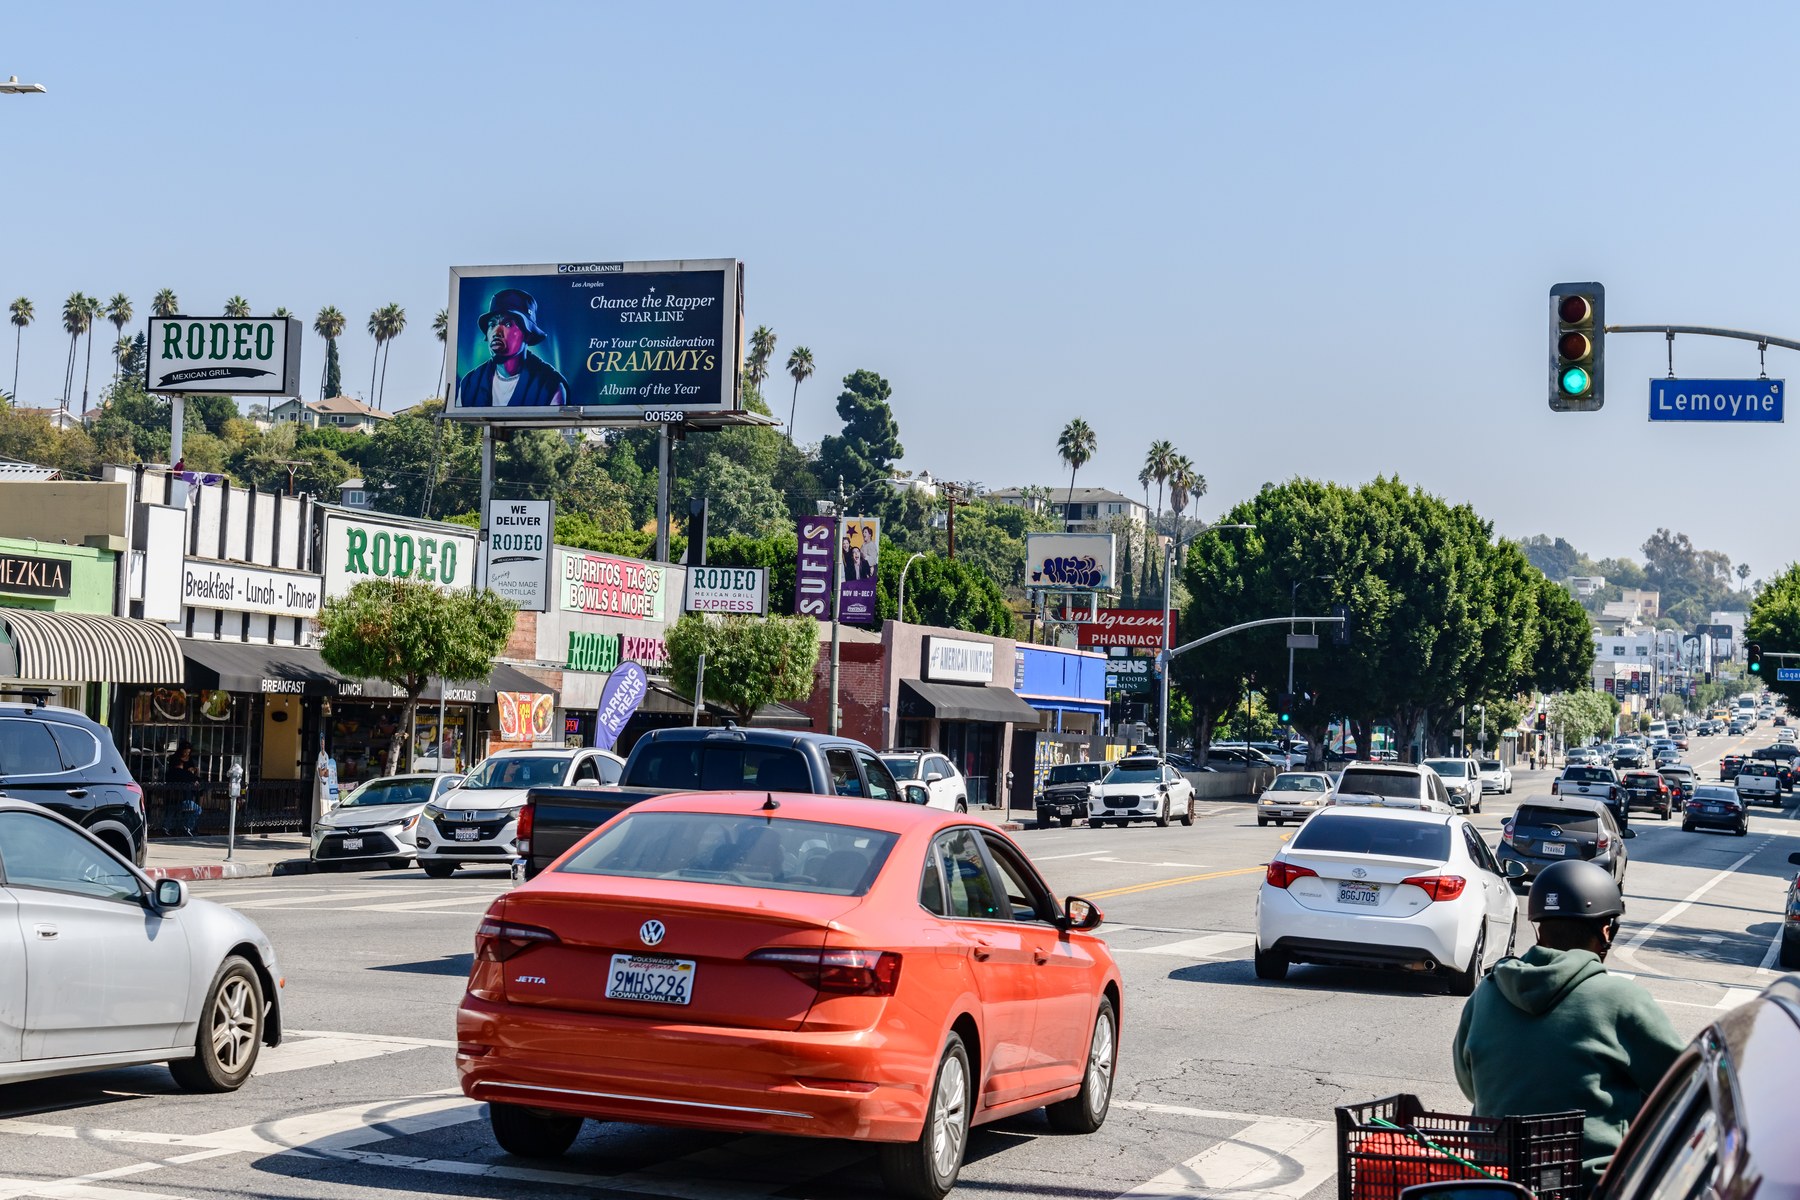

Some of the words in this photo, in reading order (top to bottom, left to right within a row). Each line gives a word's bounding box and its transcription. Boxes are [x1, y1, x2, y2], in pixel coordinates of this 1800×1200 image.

[582, 280, 604, 289] Angeles
[590, 296, 638, 309] Chance
[641, 295, 662, 308] the
[665, 294, 715, 310] Rapper
[620, 311, 652, 323] STAR
[654, 310, 685, 322] LINE
[162, 322, 275, 361] RODEO
[588, 338, 608, 349] For
[611, 338, 637, 348] Your
[639, 336, 715, 348] Consideration
[586, 350, 715, 373] GRAMMYs
[172, 370, 207, 381] MEXICAN
[208, 369, 231, 377] GRILL
[599, 383, 638, 395] Album
[639, 383, 654, 398] of
[653, 384, 672, 395] the
[674, 383, 701, 395] Year
[1659, 389, 1775, 417] Lemoyne
[645, 411, 684, 422] 001526
[510, 505, 527, 514] WE
[496, 516, 541, 526] DELIVER
[492, 533, 543, 551] RODEO
[345, 526, 457, 585] RODEO
[566, 556, 624, 592] BURRITOS,
[626, 566, 660, 593] TACOS
[800, 524, 829, 614] SUFFS
[693, 569, 756, 591] RODEO
[185, 571, 234, 601] Breakfast
[246, 577, 275, 605] Lunch
[286, 582, 317, 610] Dinner
[500, 588, 537, 596] TORTILLAS
[569, 583, 609, 612] BOWLS
[611, 589, 619, 613] &
[620, 590, 654, 618] MORE!
[694, 599, 754, 611] EXPRESS
[1091, 634, 1163, 646] PHARMACY
[569, 631, 619, 672] RODEO
[940, 646, 969, 672] AMERICAN
[969, 648, 993, 673] VINTAGE
[261, 679, 306, 694] BREAKFAST
[338, 683, 362, 696] LUNCH
[599, 668, 639, 726] PARKING
[608, 714, 621, 733] IN
[616, 678, 644, 717] REAR
[1340, 889, 1376, 903] 8GGJ705
[629, 961, 674, 972] California
[632, 956, 676, 965] VOLKSWAGEN
[515, 975, 547, 985] JETTA
[613, 970, 688, 997] 9MHS296
[610, 990, 665, 1002] DOWNTOWN
